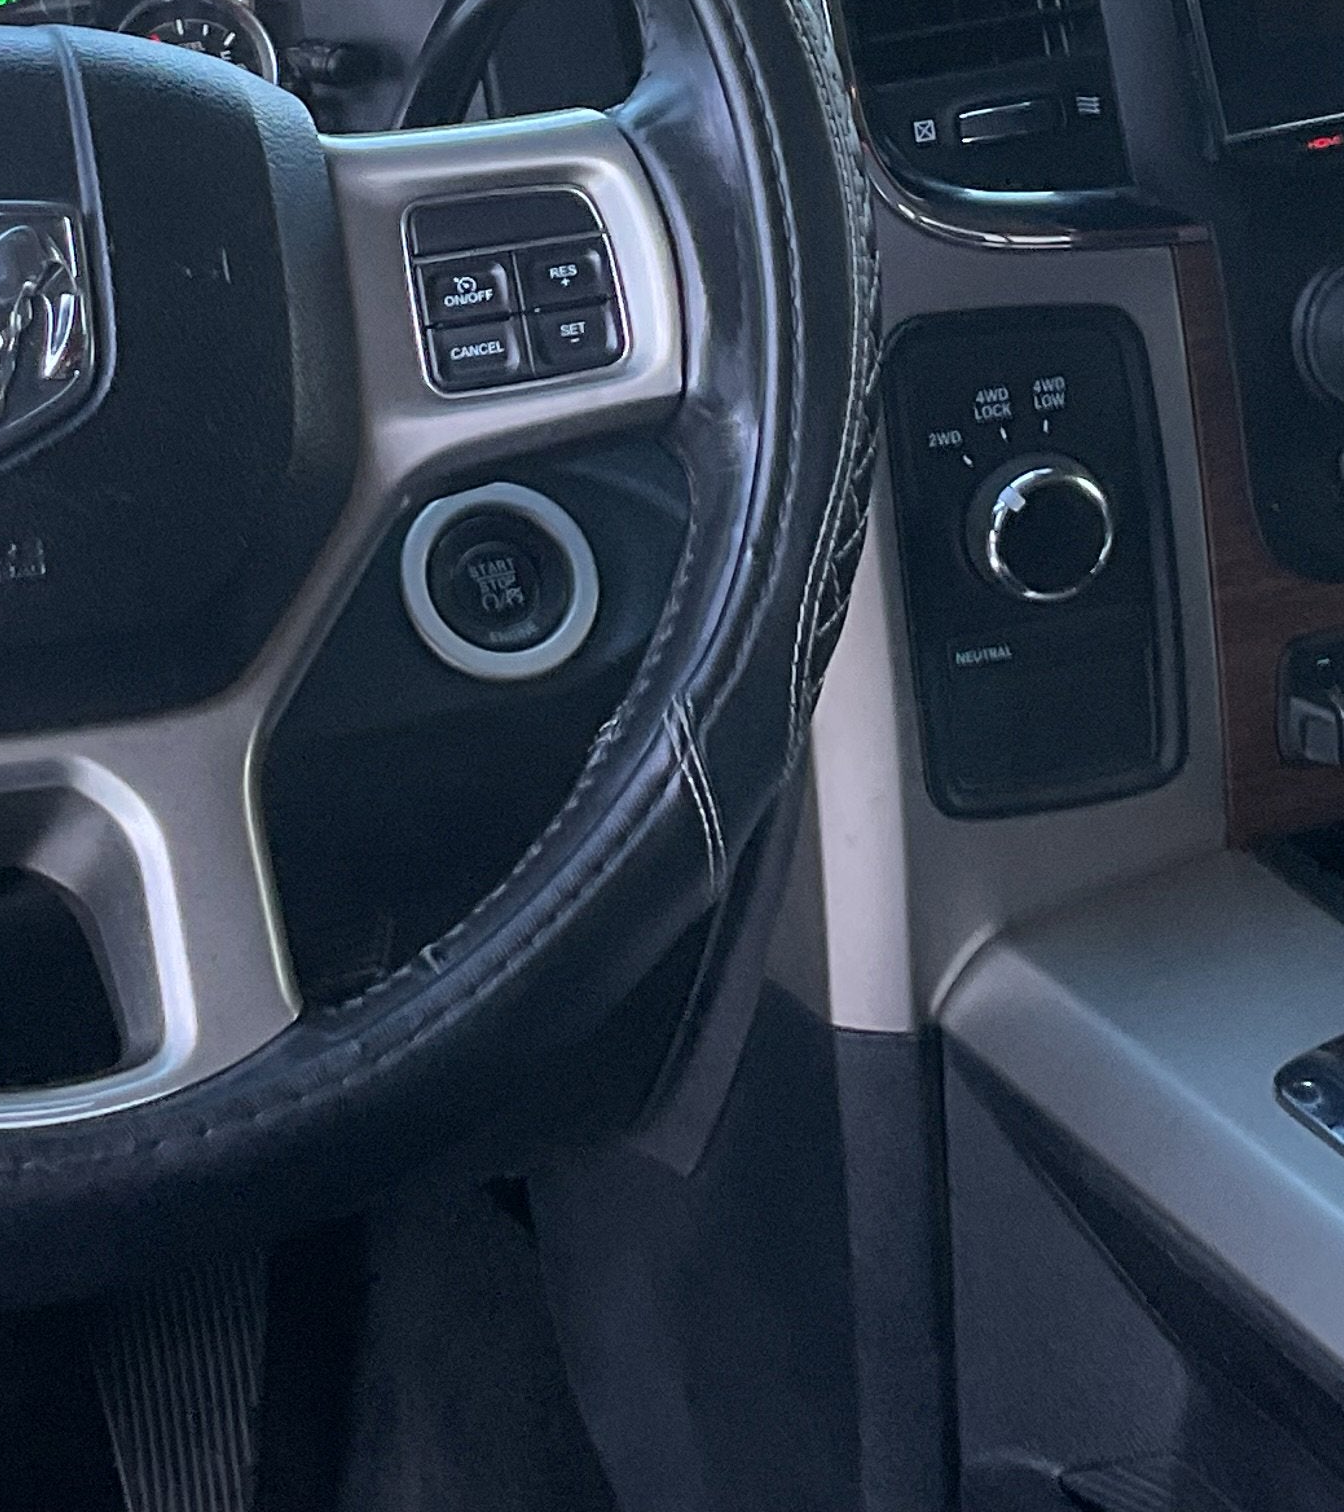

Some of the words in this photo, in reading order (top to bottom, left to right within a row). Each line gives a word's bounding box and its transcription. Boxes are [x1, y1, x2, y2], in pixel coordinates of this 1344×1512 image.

[549, 264, 578, 279] RES
[444, 289, 494, 307] ON/OFF
[560, 322, 586, 337] SET
[450, 341, 505, 360] CANCEL
[1033, 376, 1066, 393] 4WD
[975, 388, 1009, 404] 4WD
[1033, 393, 1066, 410] LOW
[973, 402, 1013, 420] LOCK
[928, 430, 962, 447] 2WD
[955, 643, 1012, 665] NEUTRAL
